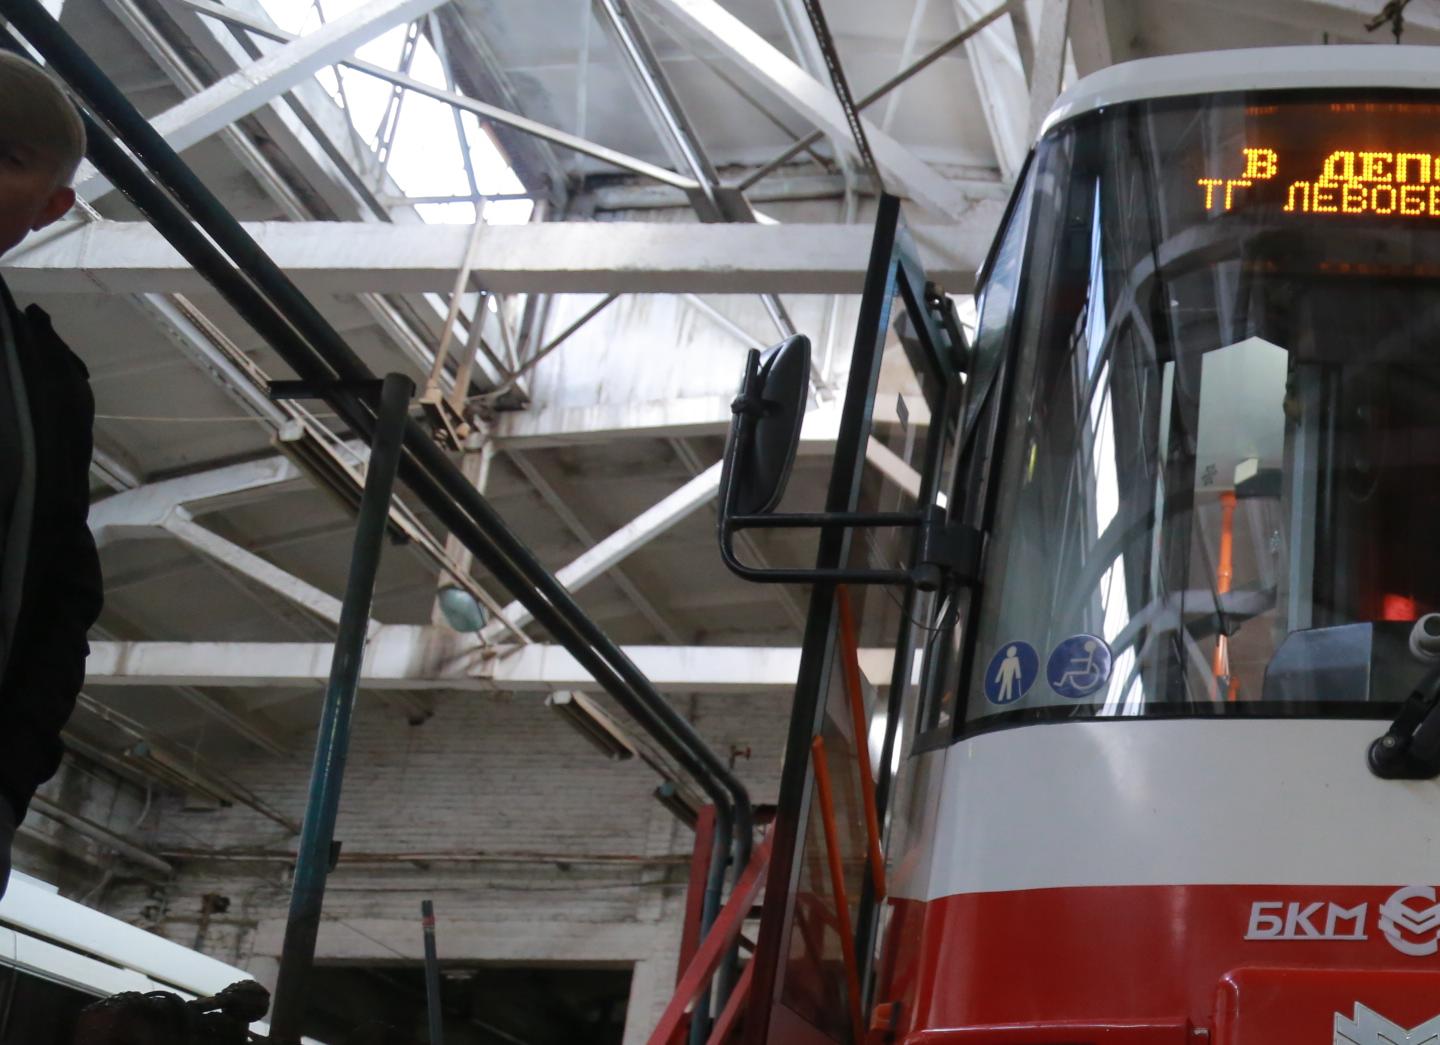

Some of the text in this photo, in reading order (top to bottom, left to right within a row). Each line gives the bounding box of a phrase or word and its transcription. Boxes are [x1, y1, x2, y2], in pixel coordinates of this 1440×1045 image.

[1242, 148, 1278, 179] В
[1198, 178, 1252, 210] ТГ
[1244, 901, 1368, 940] БКМ
